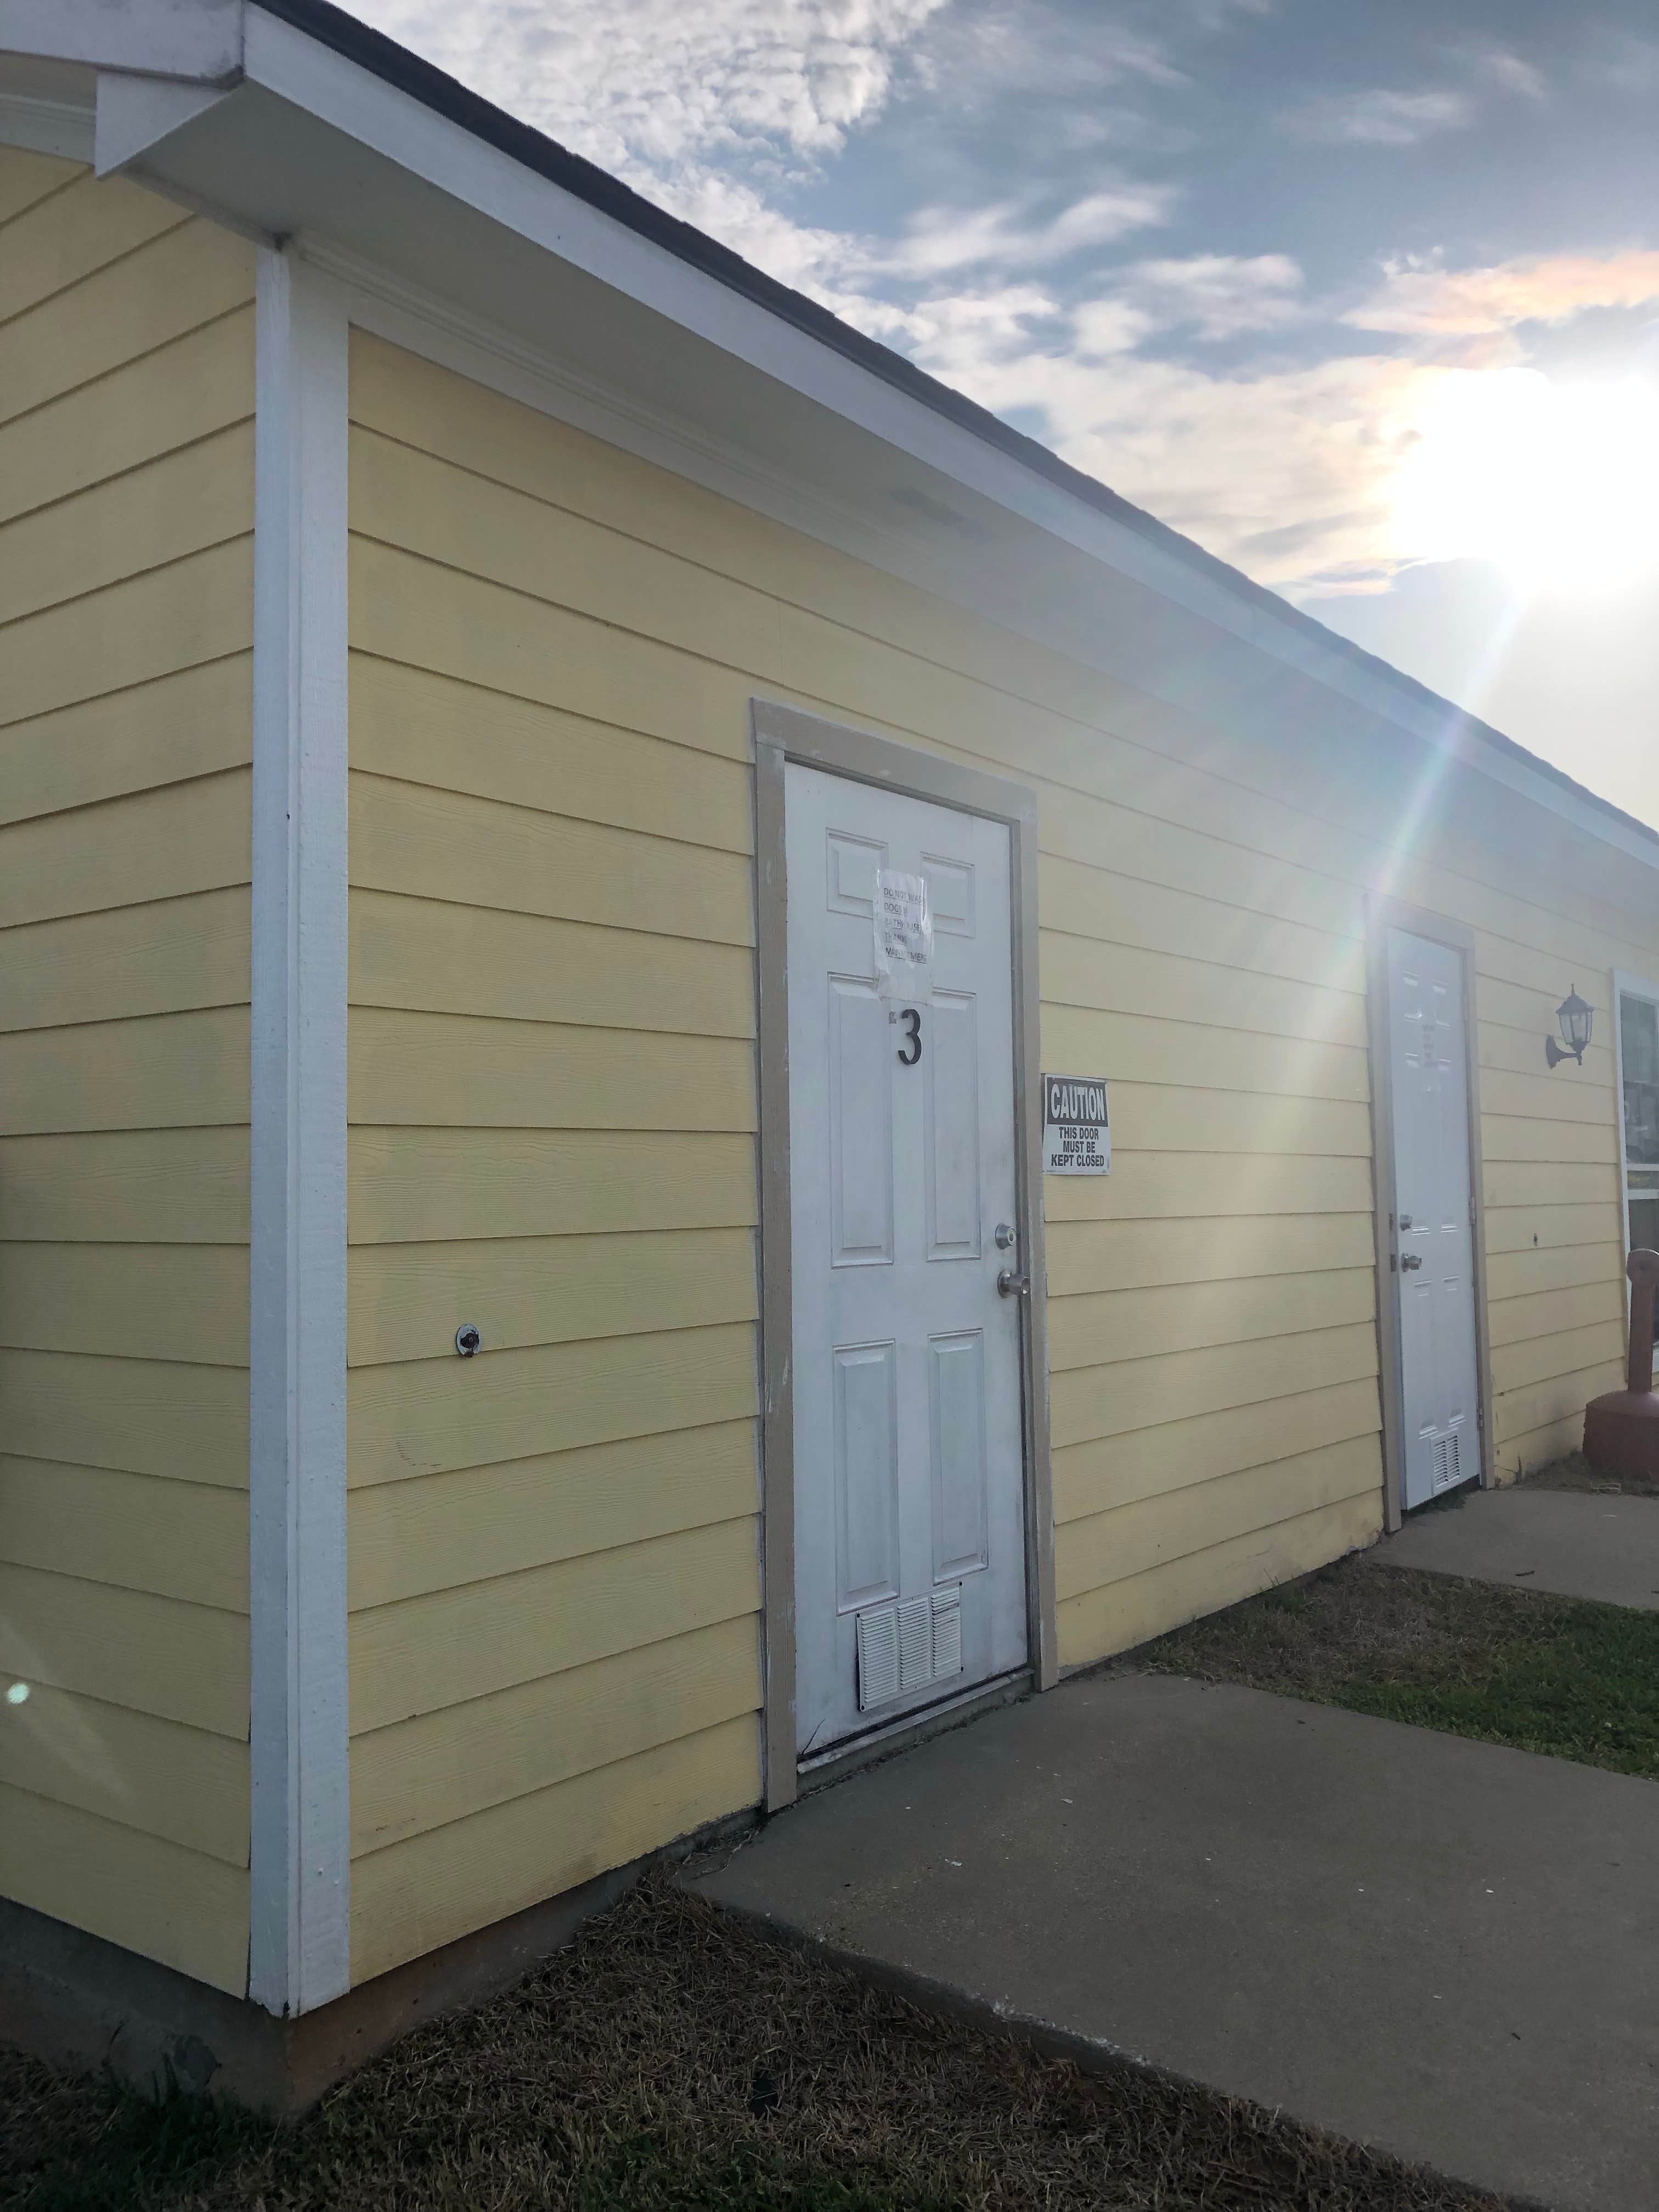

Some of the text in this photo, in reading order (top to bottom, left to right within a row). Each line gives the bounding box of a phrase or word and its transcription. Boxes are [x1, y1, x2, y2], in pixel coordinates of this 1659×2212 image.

[884, 887, 893, 896] DO
[884, 902, 902, 913] DOGS
[898, 1009, 922, 1065] 3
[1051, 1083, 1105, 1121] CAUTION
[1059, 1126, 1099, 1140] THIS DOOR
[1063, 1140, 1096, 1153] MUST BE
[1051, 1154, 1074, 1167] KEPT
[1076, 1154, 1104, 1167] CLOSED
